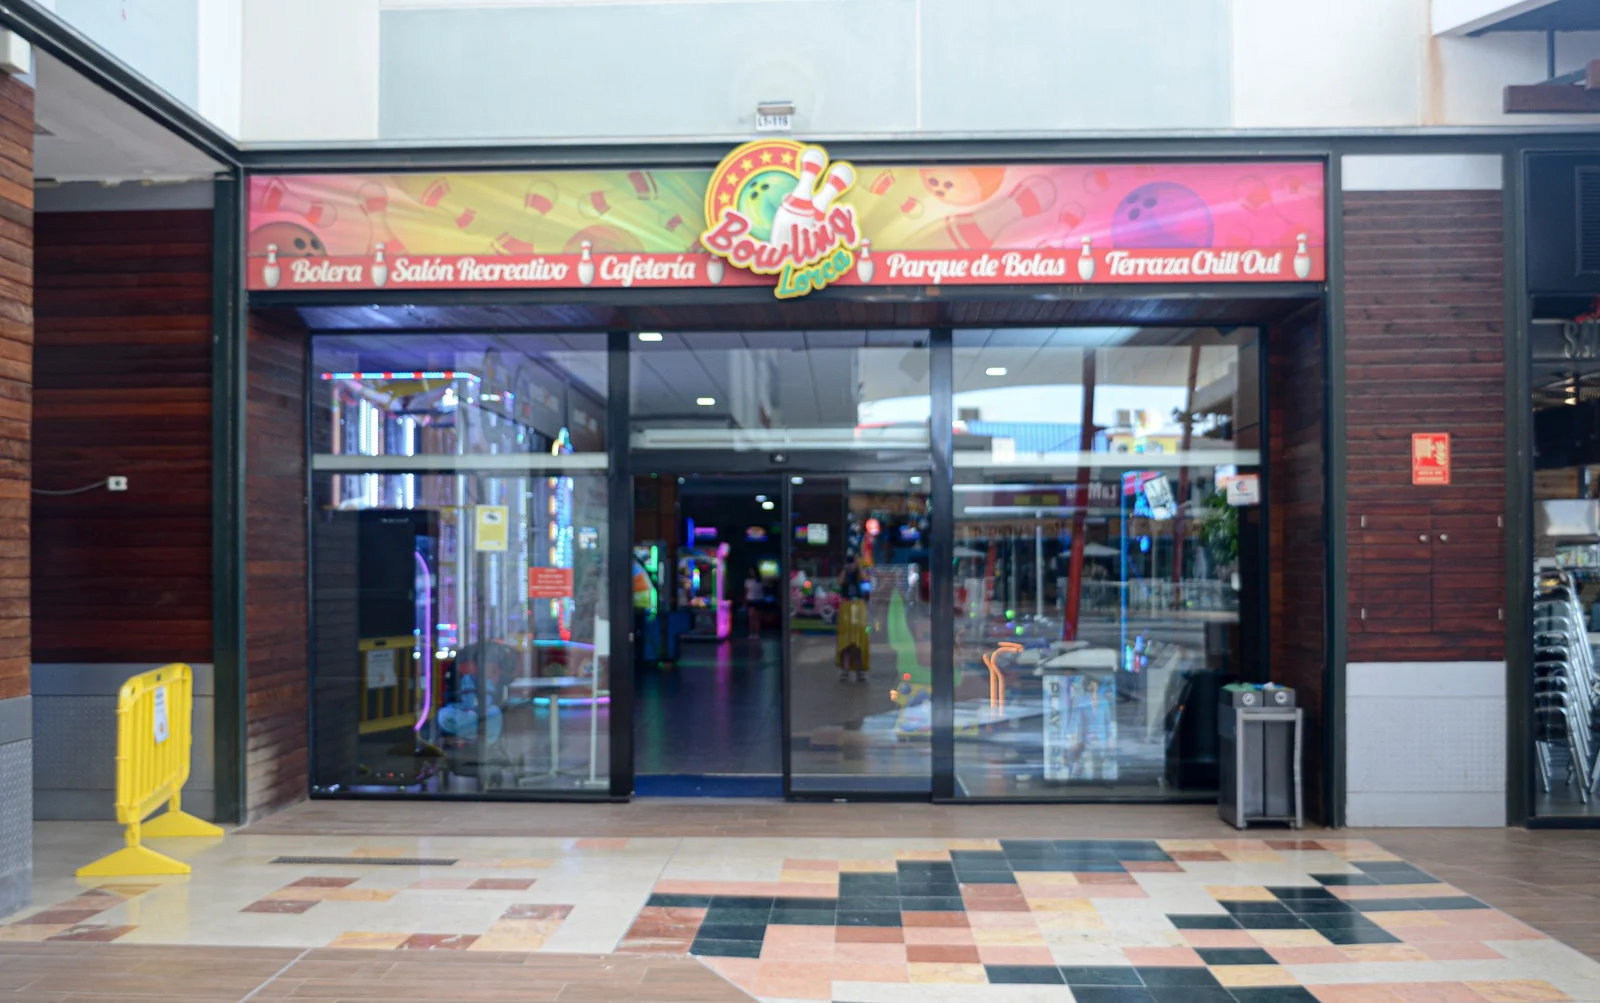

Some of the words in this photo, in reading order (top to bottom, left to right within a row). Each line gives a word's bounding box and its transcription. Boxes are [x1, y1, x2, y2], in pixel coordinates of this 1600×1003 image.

[706, 207, 858, 270] Bowling
[290, 258, 363, 283] Bolera
[391, 257, 454, 283] Salón
[456, 257, 570, 282] Recreativo
[599, 256, 696, 287] Cafetería
[779, 250, 852, 294] Lorca
[886, 253, 968, 284] Parque
[970, 254, 999, 277] de
[1001, 253, 1066, 277] Bolas
[1105, 251, 1190, 276] Terraza
[1191, 250, 1240, 275] Chill
[1240, 250, 1282, 275] Out
